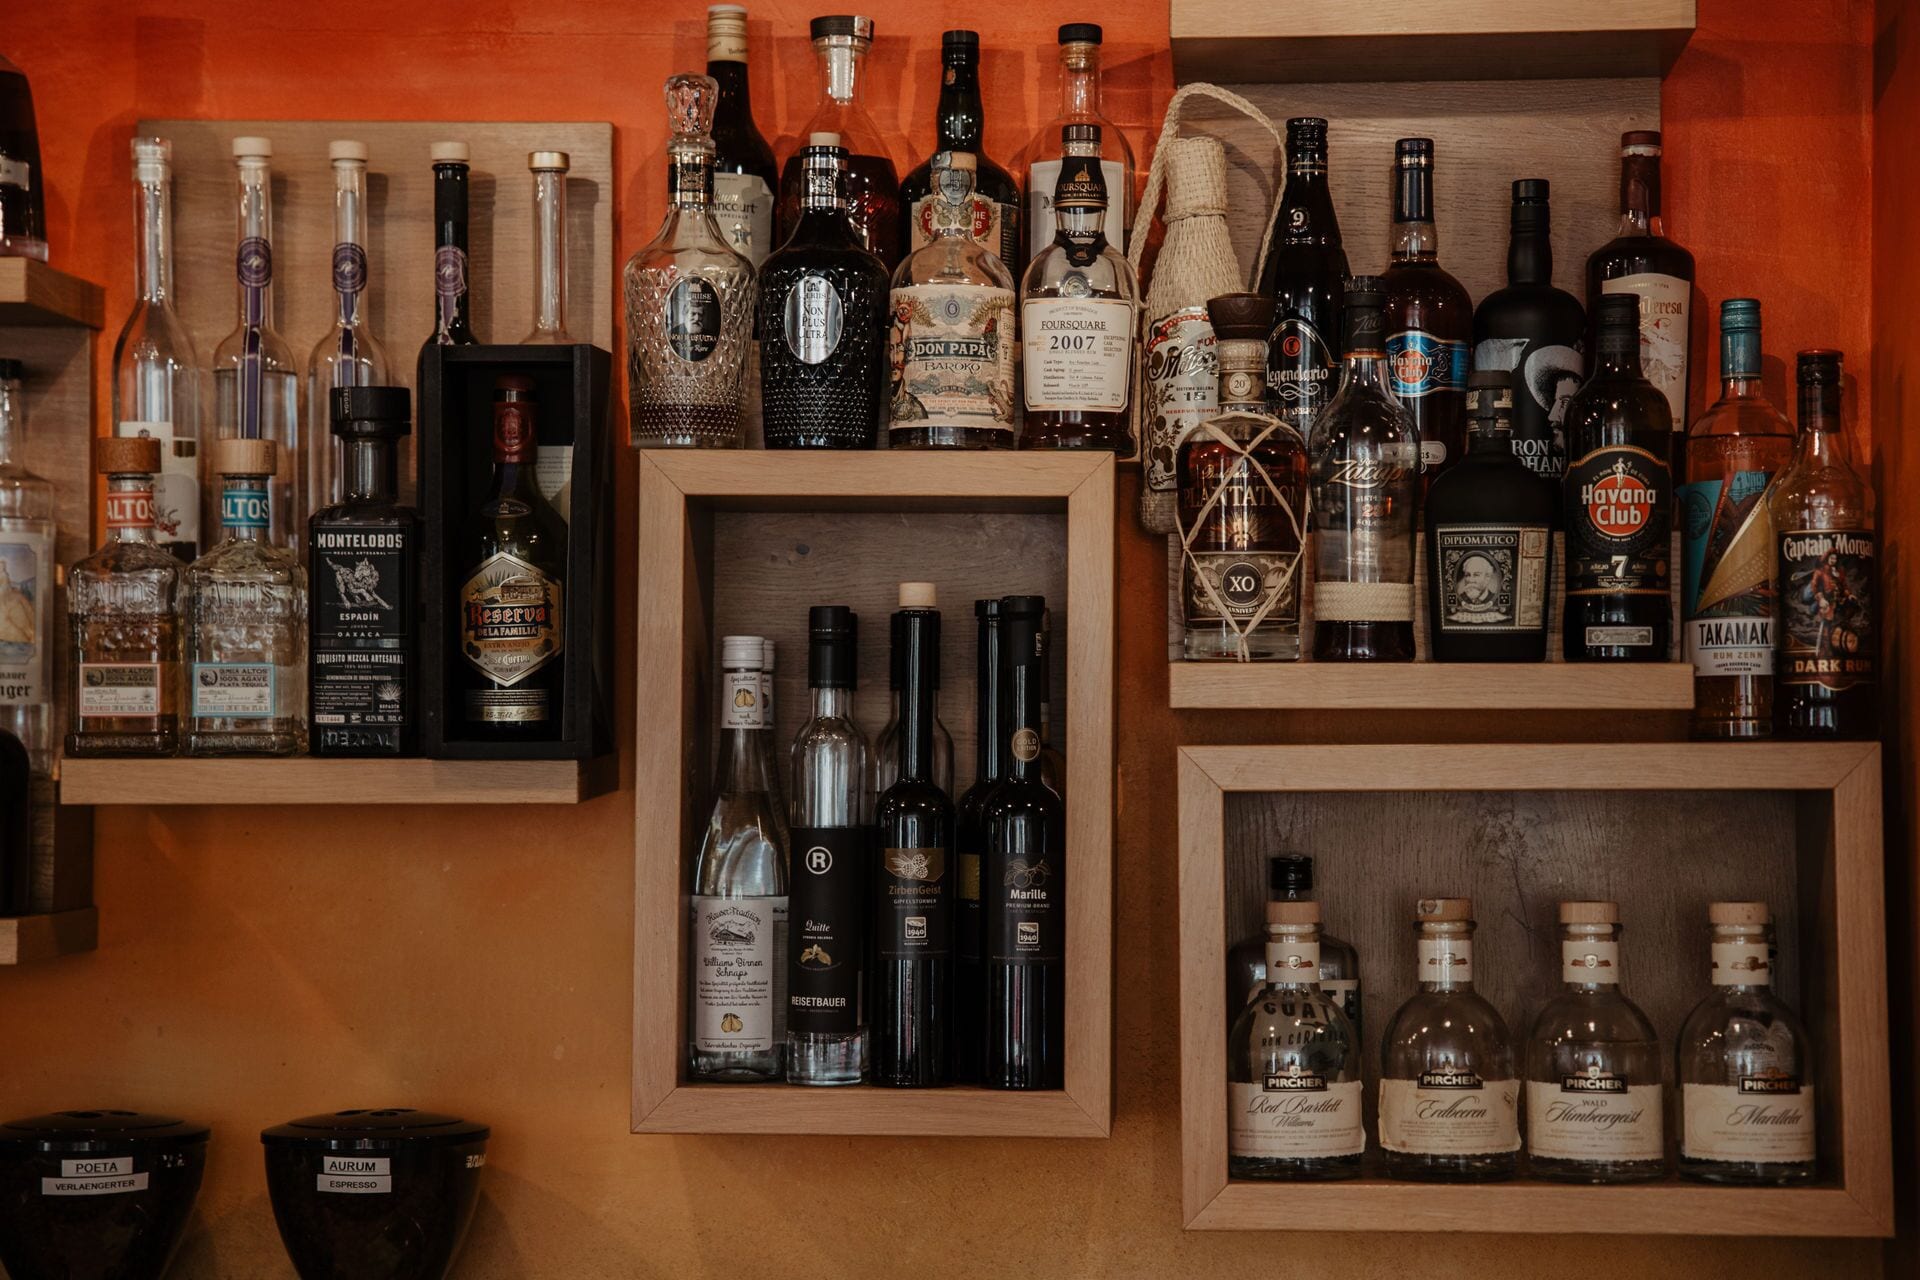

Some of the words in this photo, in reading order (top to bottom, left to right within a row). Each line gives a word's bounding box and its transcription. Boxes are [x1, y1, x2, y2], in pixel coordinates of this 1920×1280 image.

[1293, 211, 1304, 223] 9
[803, 305, 824, 316] NON
[802, 316, 826, 328] PLUS
[1041, 320, 1106, 330] FOURSQUARE
[797, 329, 828, 339] ULTRA
[1050, 335, 1096, 350] 2007
[916, 343, 945, 355] DON
[949, 343, 986, 356] PAPA
[1389, 354, 1433, 367] Havana
[925, 361, 981, 374] BAROKO
[1398, 366, 1423, 378] Club
[1265, 364, 1329, 388] Legendario
[1233, 379, 1245, 389] 20
[1511, 439, 1550, 456] RON
[1581, 483, 1656, 505] Havana
[1596, 505, 1641, 525] Club
[317, 533, 403, 548] MONTELOBOS
[1444, 534, 1514, 545] DIPLOMÁTICO
[1783, 534, 1832, 562] Captain
[1611, 554, 1629, 578] 7
[1229, 576, 1255, 592] XO
[339, 612, 379, 621] ESPADÍN
[469, 603, 546, 625] Reserva
[316, 654, 346, 664] EXQUISITO
[347, 654, 370, 662] MEZCAL
[370, 654, 404, 664] ARTESANAL
[1713, 651, 1733, 659] RUM
[1737, 651, 1763, 659] ZENN
[1795, 659, 1841, 673] DARK
[1846, 659, 1872, 672] RUM
[888, 885, 942, 895] ZirbenGeist
[1010, 889, 1047, 900] Marille
[804, 919, 831, 932] Quitte
[715, 967, 748, 980] Schnaps
[791, 996, 846, 1007] REISETBAUER
[1267, 1078, 1323, 1088] PIRCHER
[1565, 1078, 1623, 1089] PIRCHER
[1246, 1095, 1284, 1114] Red
[1283, 1095, 1343, 1114] Bartlett
[1415, 1095, 1488, 1120] Erdbeeren
[1271, 1115, 1315, 1127] Williams
[1545, 1101, 1645, 1131] Himbeergeist
[75, 1162, 118, 1173] POETA
[329, 1161, 376, 1172] AURUM
[55, 1180, 136, 1191] VERLAENGERTER
[329, 1180, 377, 1189] ESPRESSO
